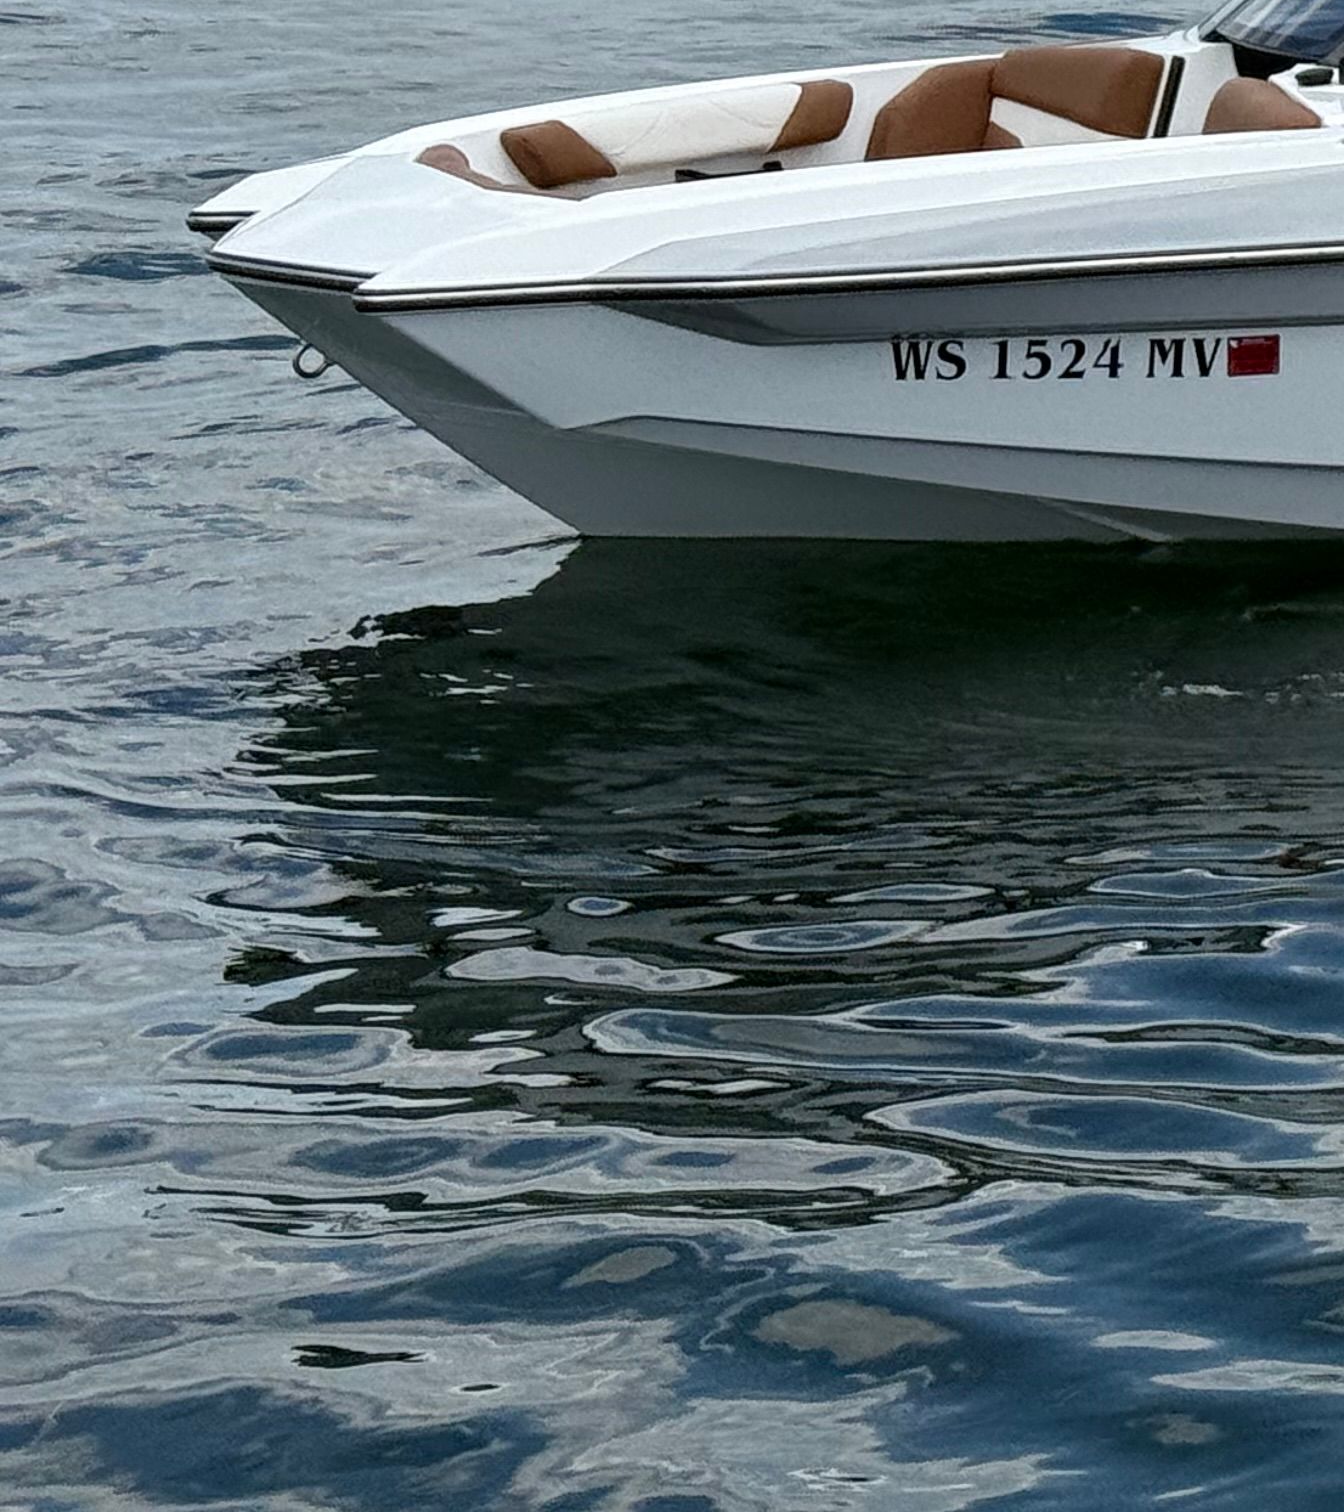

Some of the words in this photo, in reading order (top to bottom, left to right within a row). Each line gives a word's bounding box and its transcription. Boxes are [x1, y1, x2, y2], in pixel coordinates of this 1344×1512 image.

[890, 338, 967, 381] WS
[990, 338, 1124, 380] 1524
[1146, 337, 1221, 378] MV
